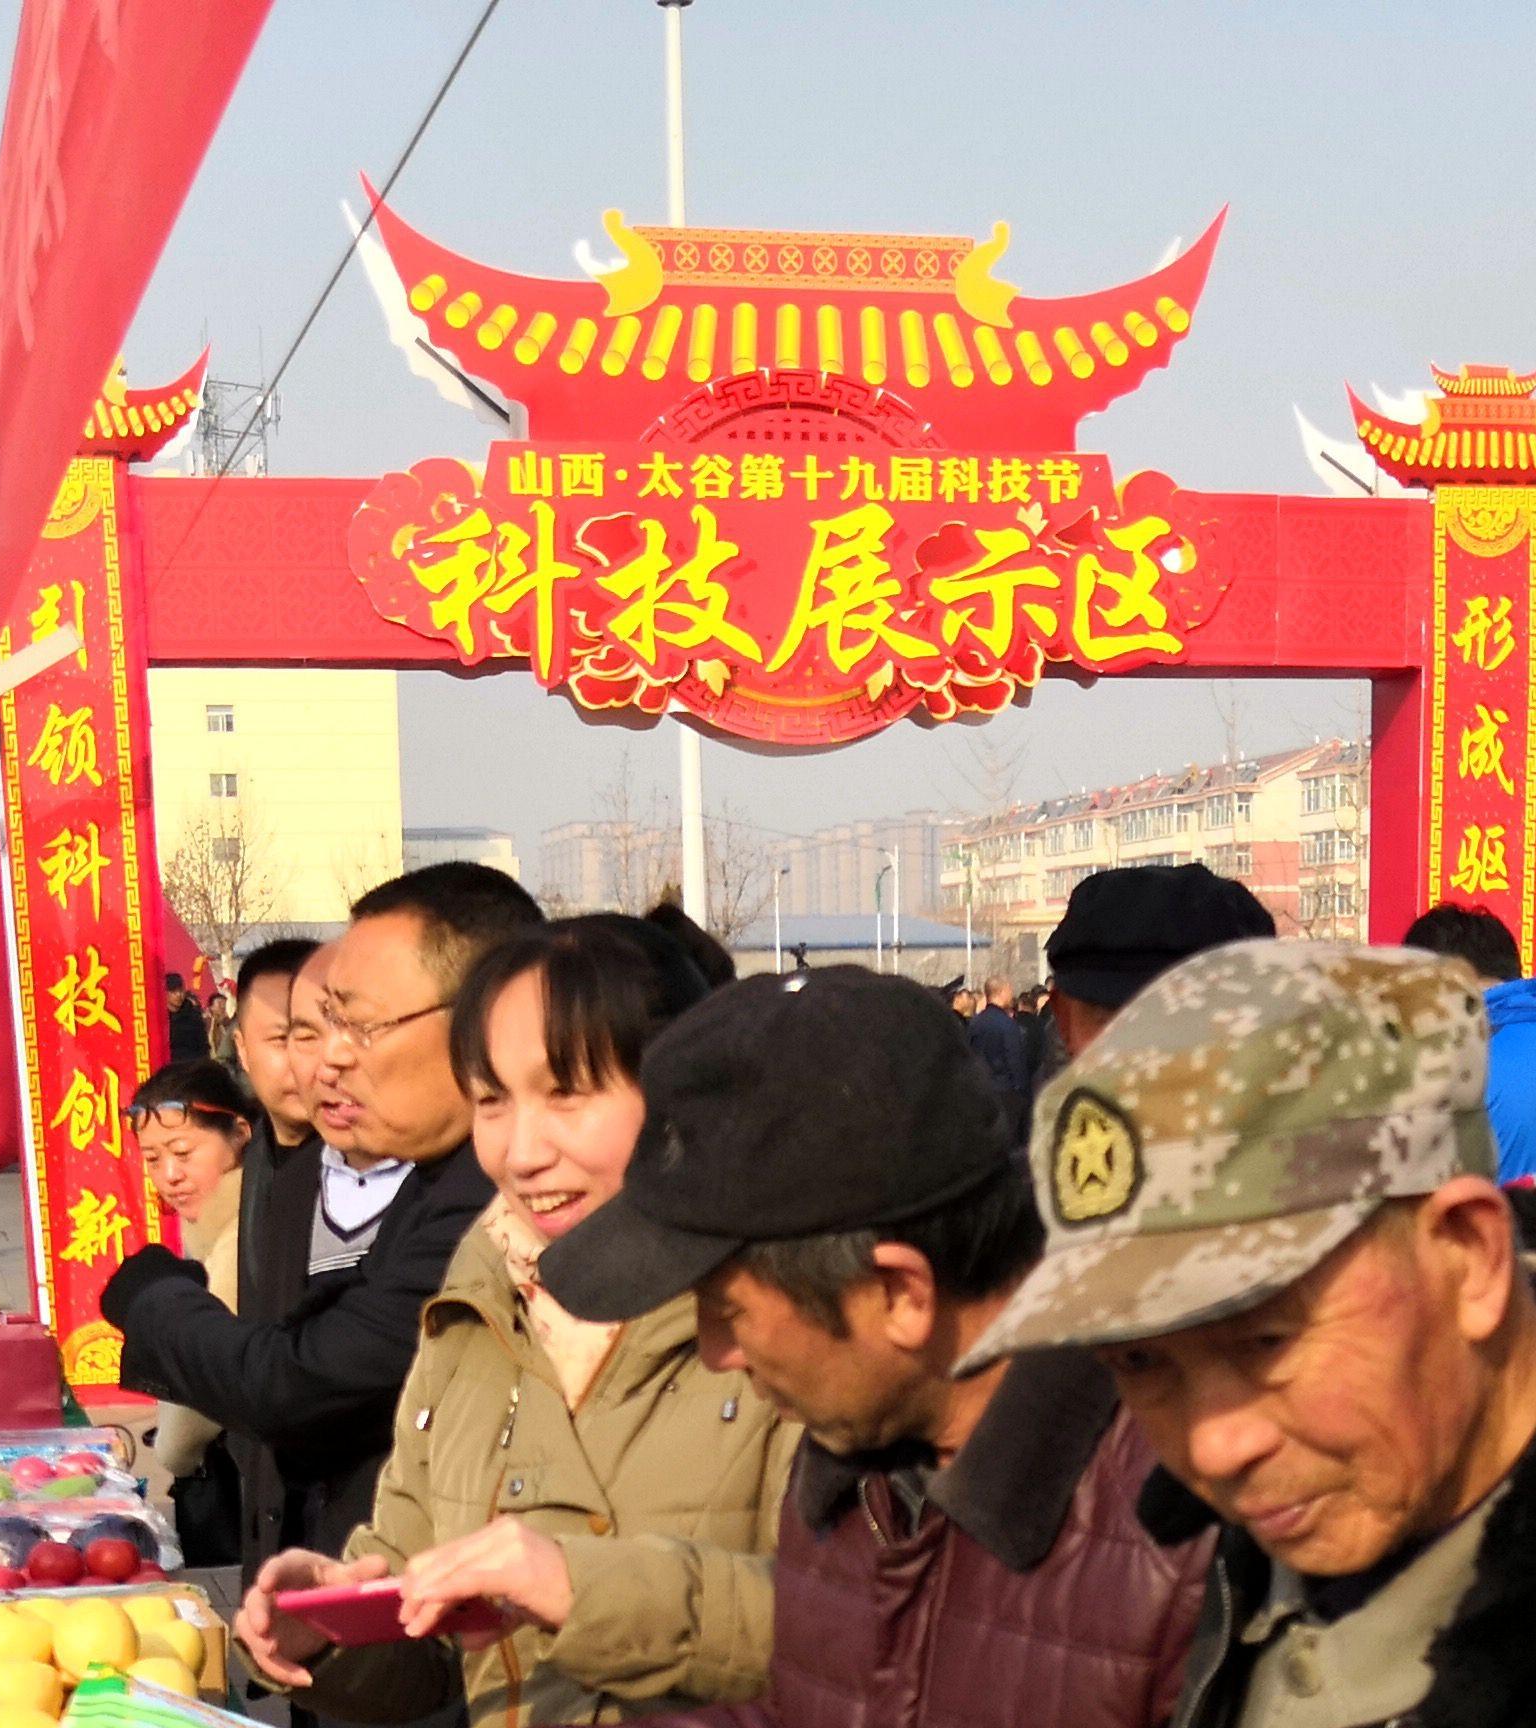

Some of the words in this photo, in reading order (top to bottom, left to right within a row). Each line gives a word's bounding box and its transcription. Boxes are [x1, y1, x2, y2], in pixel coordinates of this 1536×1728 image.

[507, 449, 1082, 504] 山西·太谷第十九届科技节
[409, 501, 1185, 683] 科技展示区
[27, 579, 131, 1268] 引领科技创新
